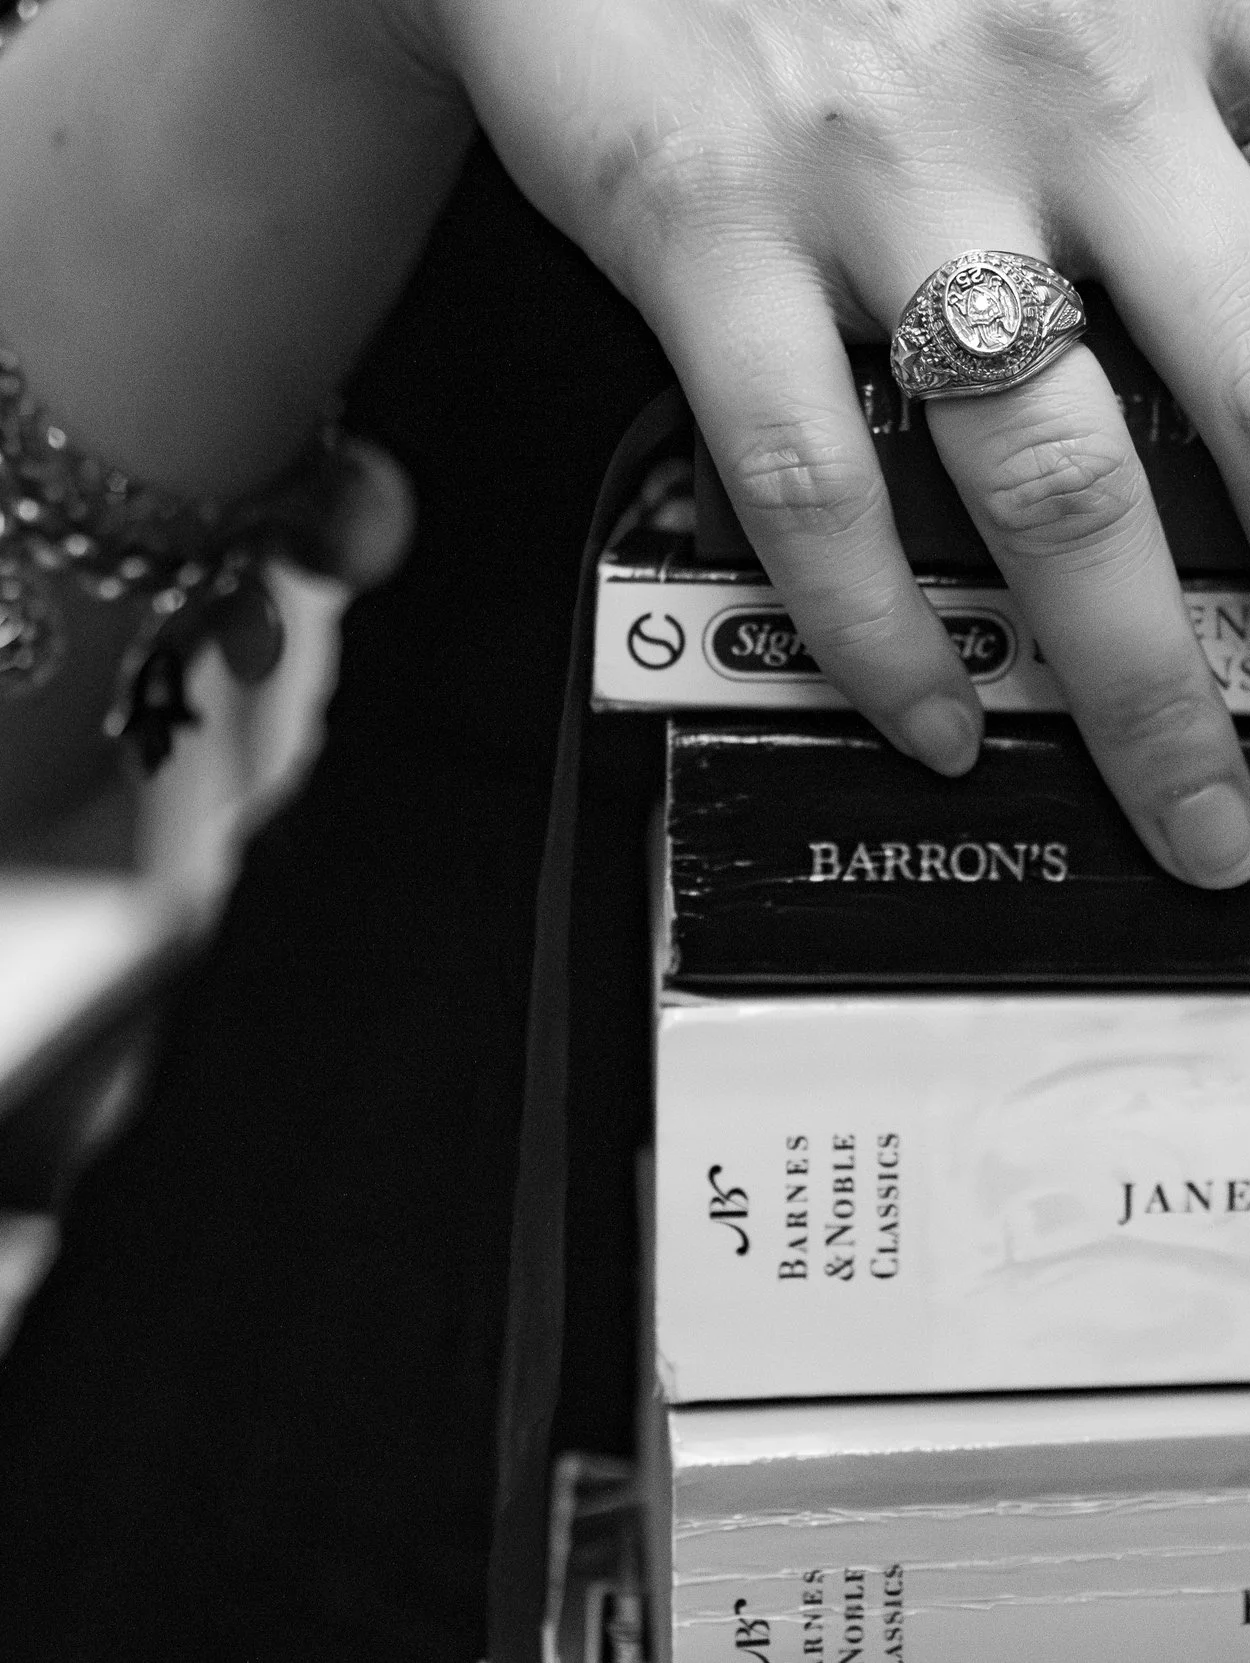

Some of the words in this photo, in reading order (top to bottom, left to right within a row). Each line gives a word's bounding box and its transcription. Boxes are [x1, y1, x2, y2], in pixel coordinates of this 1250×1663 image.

[808, 842, 1069, 883] BARRON'S
[777, 1134, 808, 1282] BARNES
[869, 1132, 899, 1280] CLASSICS
[803, 1568, 823, 1663] RNES
[884, 1563, 903, 1663] ASSICS
